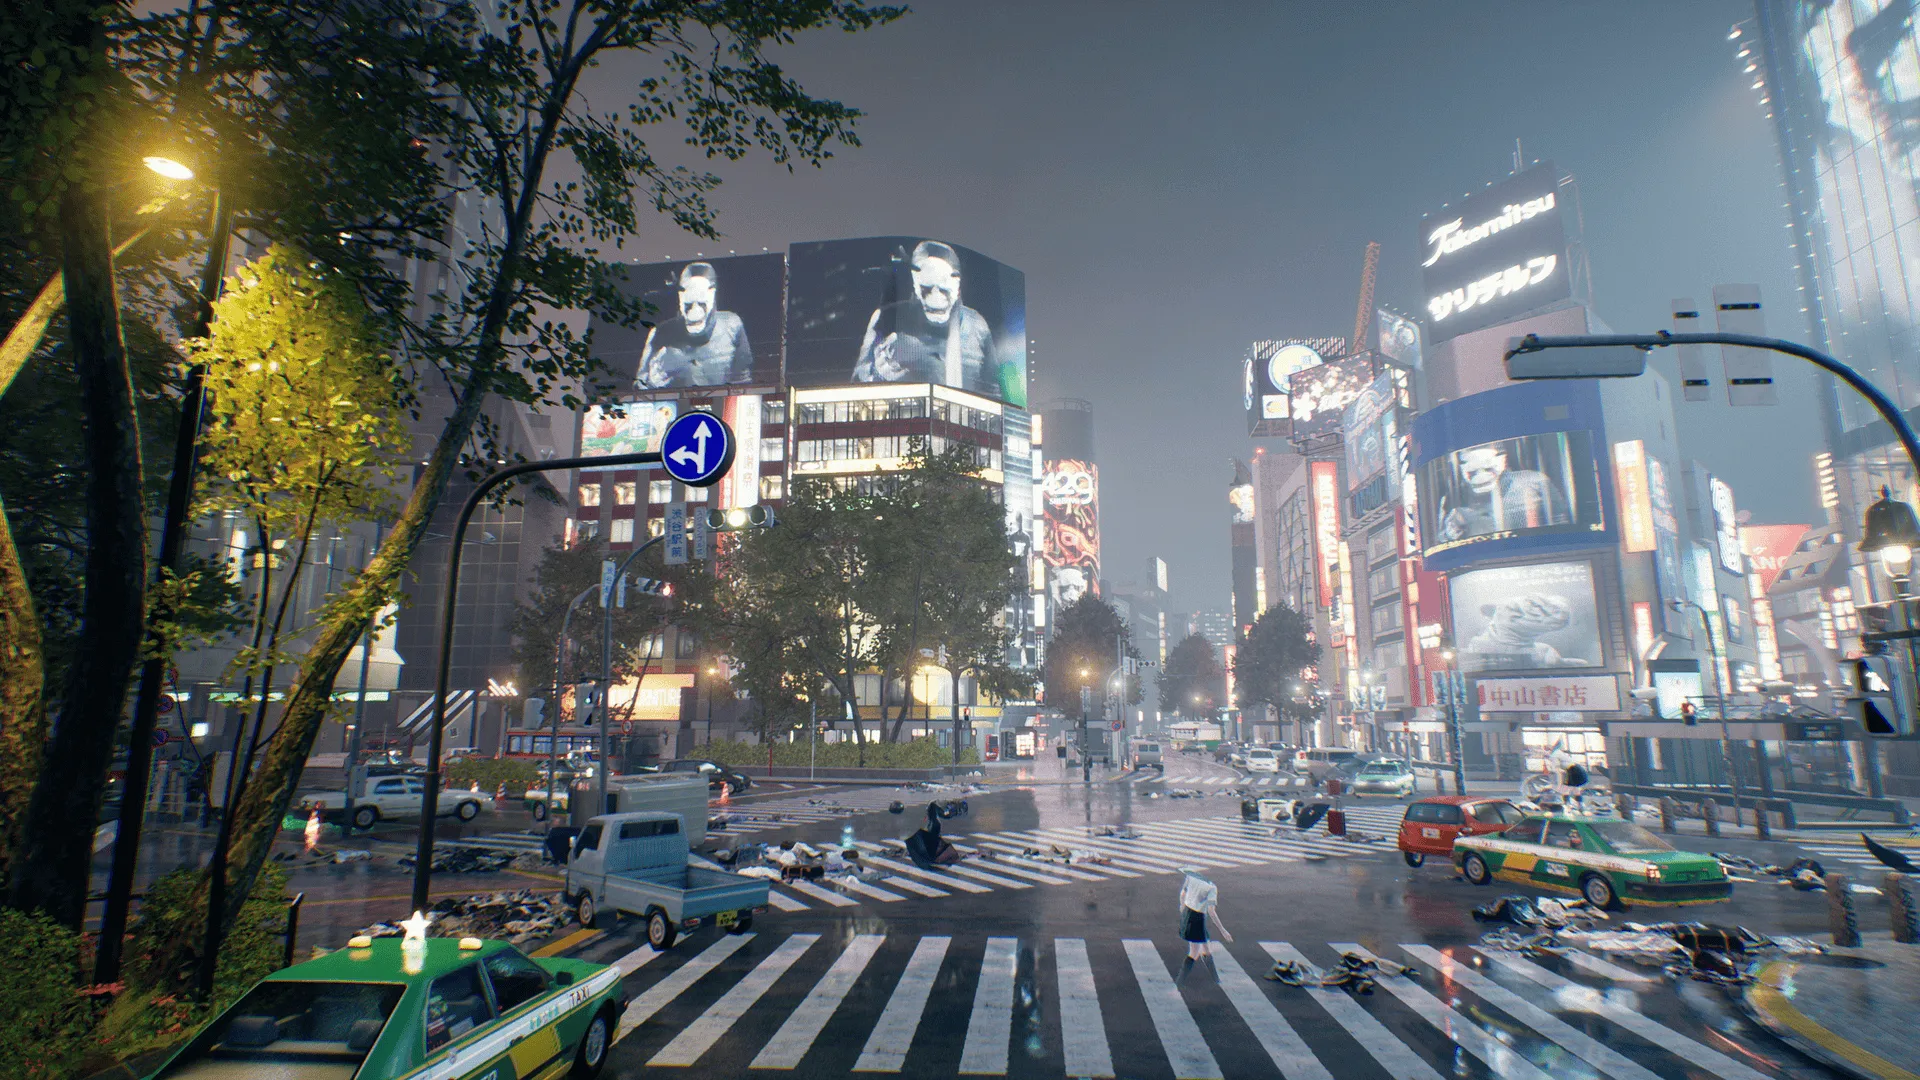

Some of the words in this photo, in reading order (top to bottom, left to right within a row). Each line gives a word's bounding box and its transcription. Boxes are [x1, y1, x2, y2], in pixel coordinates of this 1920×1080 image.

[1421, 191, 1556, 268] Takemitsu
[1041, 471, 1094, 504] 429
[1490, 684, 1587, 706] 中山書店
[569, 985, 590, 1006] TAXI
